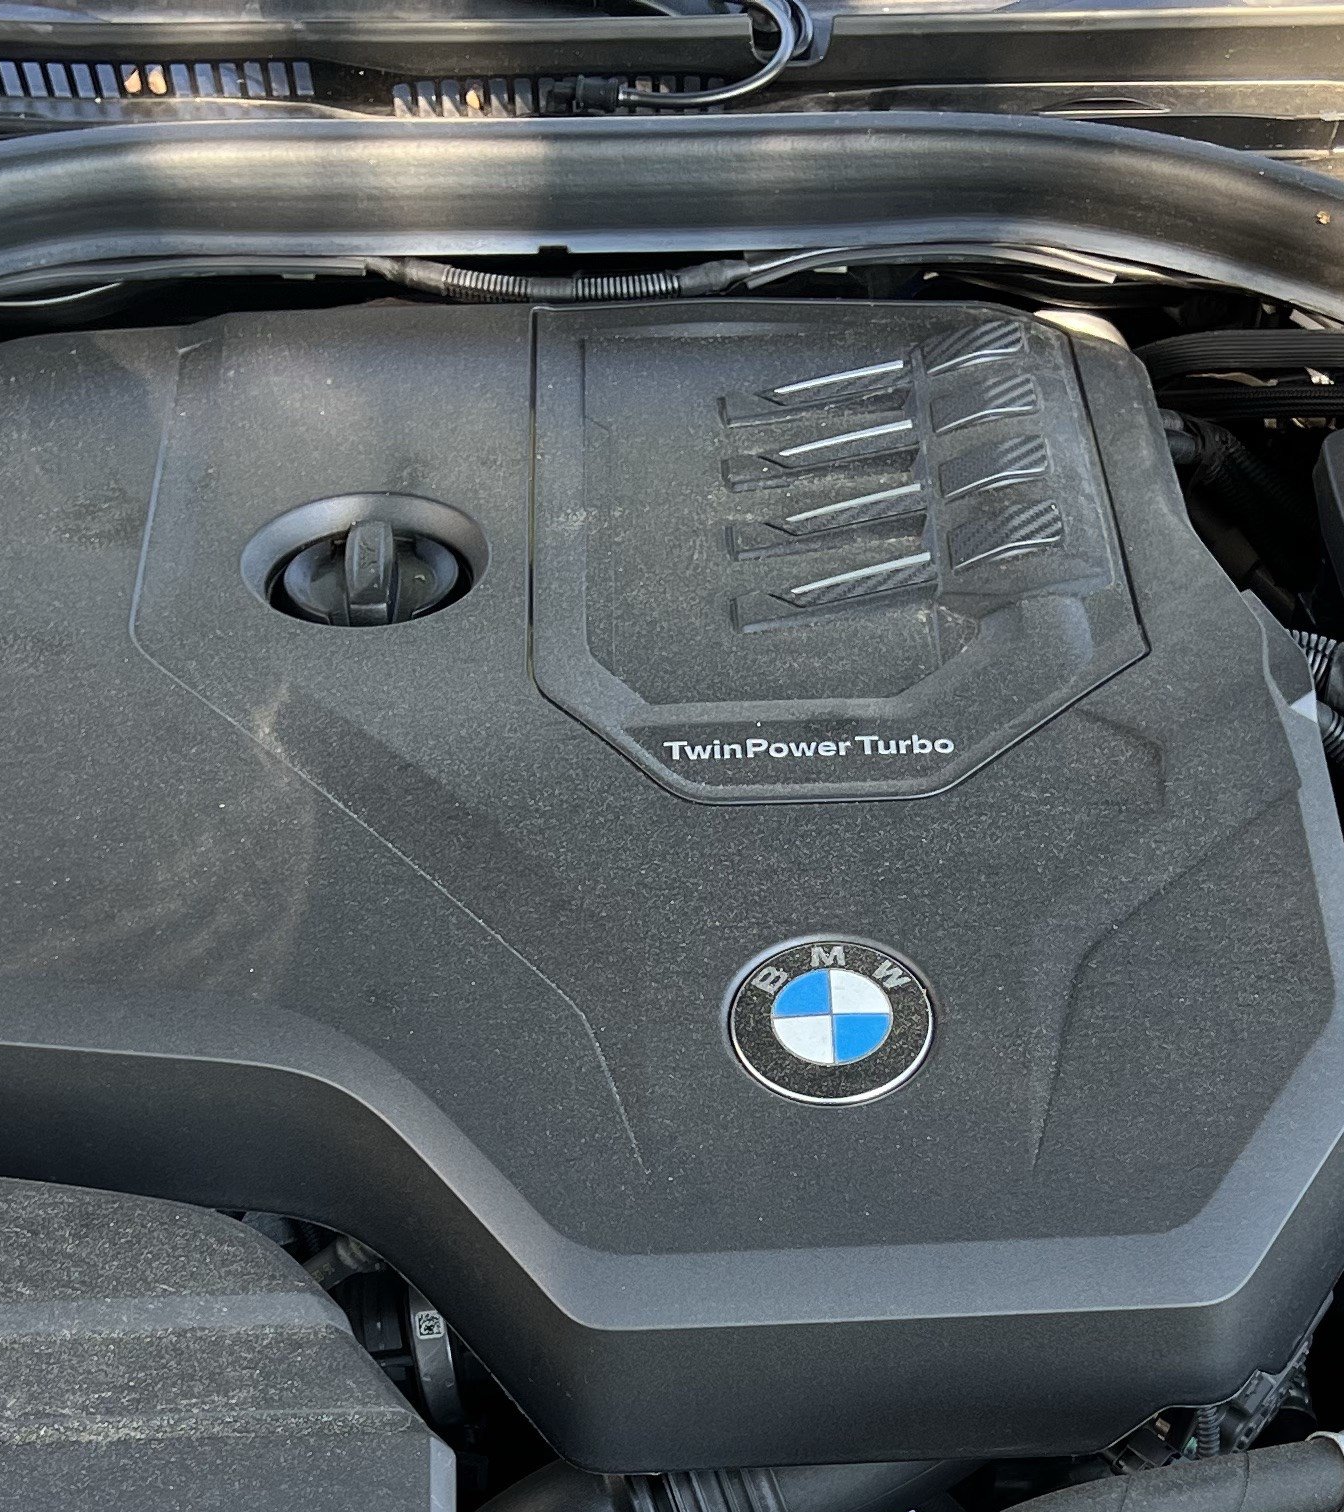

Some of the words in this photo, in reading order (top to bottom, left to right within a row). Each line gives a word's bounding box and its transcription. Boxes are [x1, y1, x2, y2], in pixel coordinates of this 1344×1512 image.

[663, 738, 851, 761] TwinPower
[855, 734, 954, 755] Turbo
[752, 945, 912, 995] BMW
